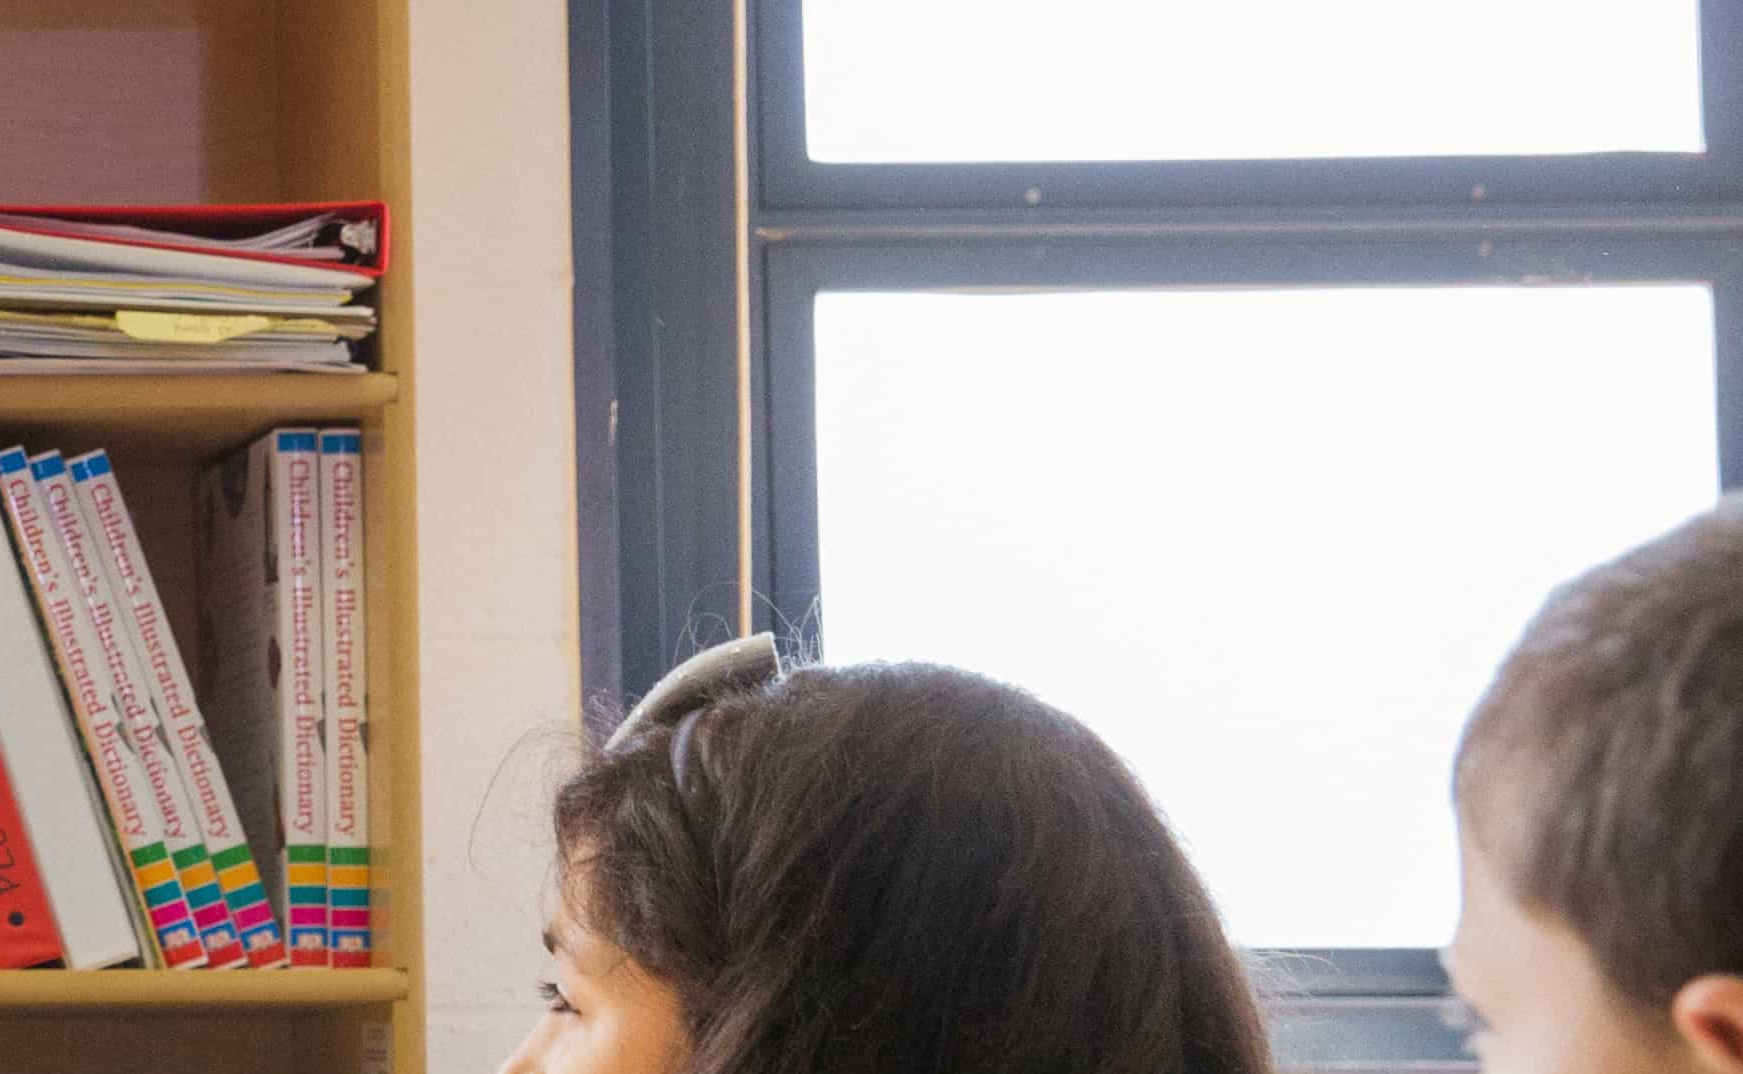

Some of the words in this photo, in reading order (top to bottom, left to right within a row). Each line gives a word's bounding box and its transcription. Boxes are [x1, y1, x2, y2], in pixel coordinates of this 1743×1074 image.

[288, 458, 309, 575] Children's
[330, 459, 350, 580] Children's
[8, 478, 58, 594] Children's
[50, 598, 105, 716] Illustrated
[94, 718, 148, 837] Dictionary
[47, 483, 98, 599] Children's
[89, 601, 146, 720] Illustrated
[132, 725, 187, 840] Dictionary
[90, 483, 142, 599] Children's
[133, 602, 190, 719] Illustrated
[177, 722, 231, 840] Dictionary
[293, 585, 313, 706] Illustrated
[335, 588, 357, 709] Illustrated
[294, 714, 316, 834] Dictionary
[336, 716, 359, 836] Dictionary
